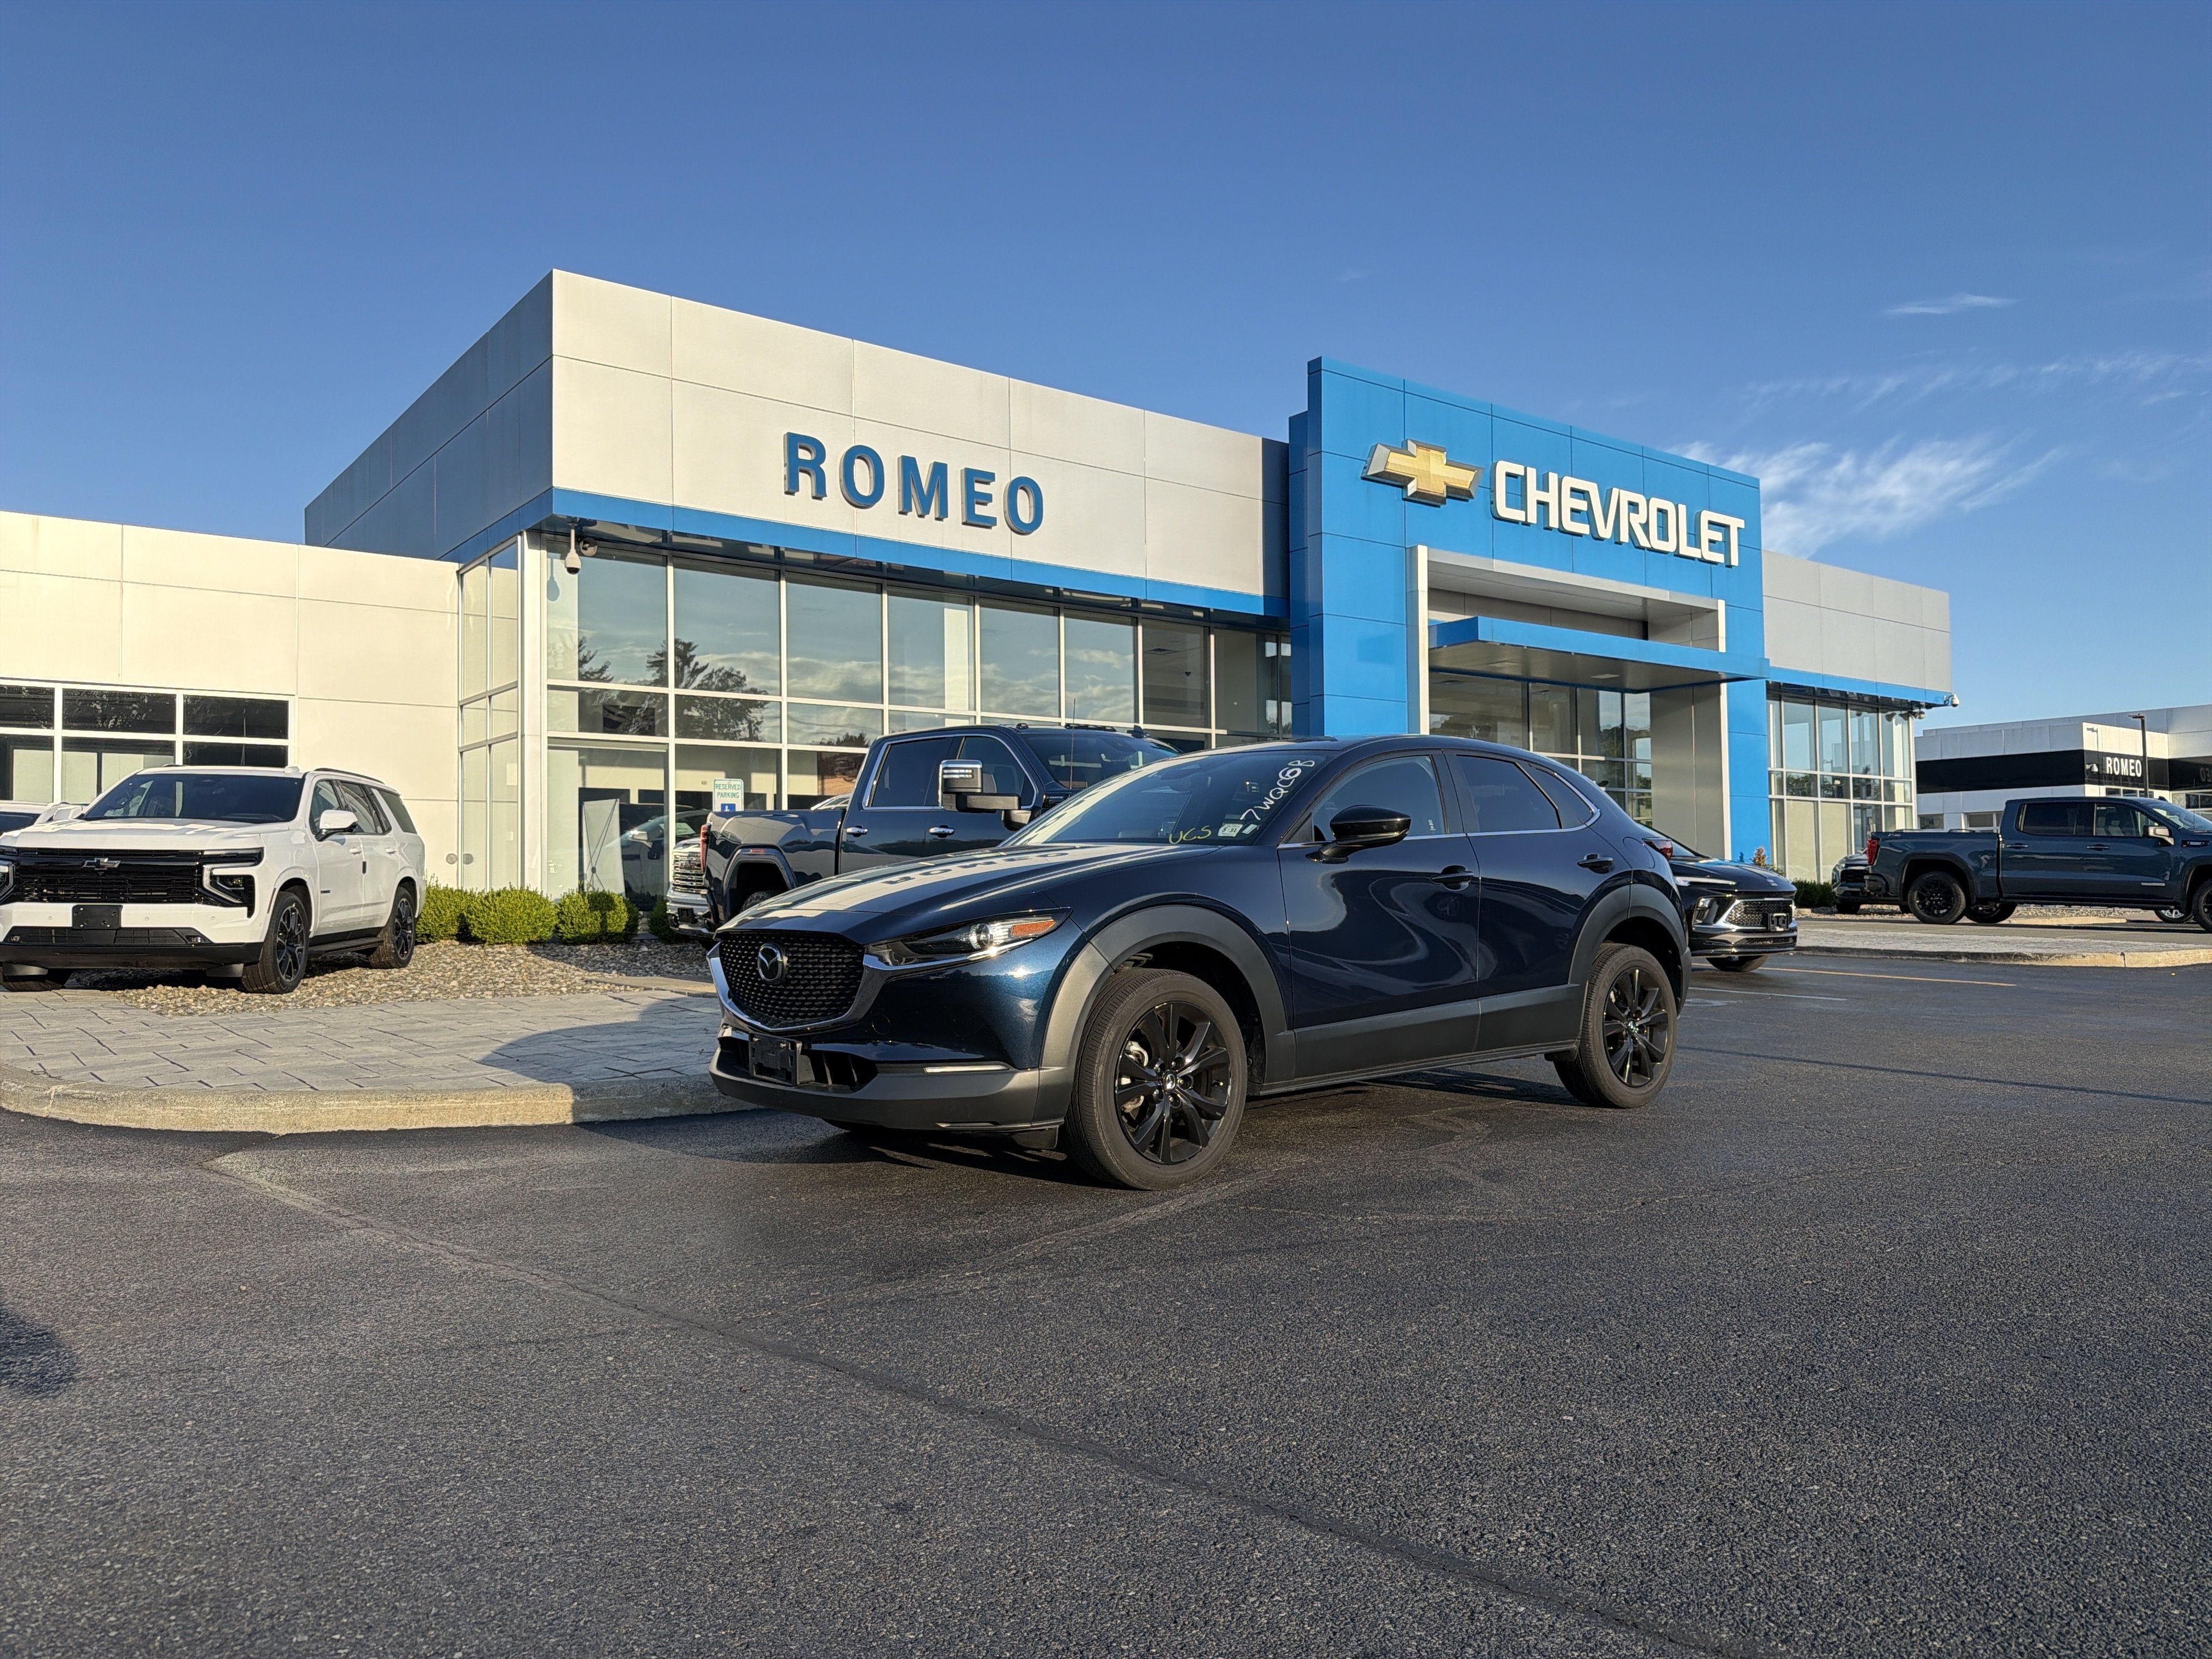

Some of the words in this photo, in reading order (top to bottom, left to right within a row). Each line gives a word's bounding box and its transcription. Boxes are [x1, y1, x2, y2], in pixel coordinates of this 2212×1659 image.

[783, 431, 1044, 536] ROMEO
[1492, 460, 1745, 567] CHEVROLET
[2106, 757, 2142, 777] ROMEO
[1169, 825, 1212, 844] UCS
